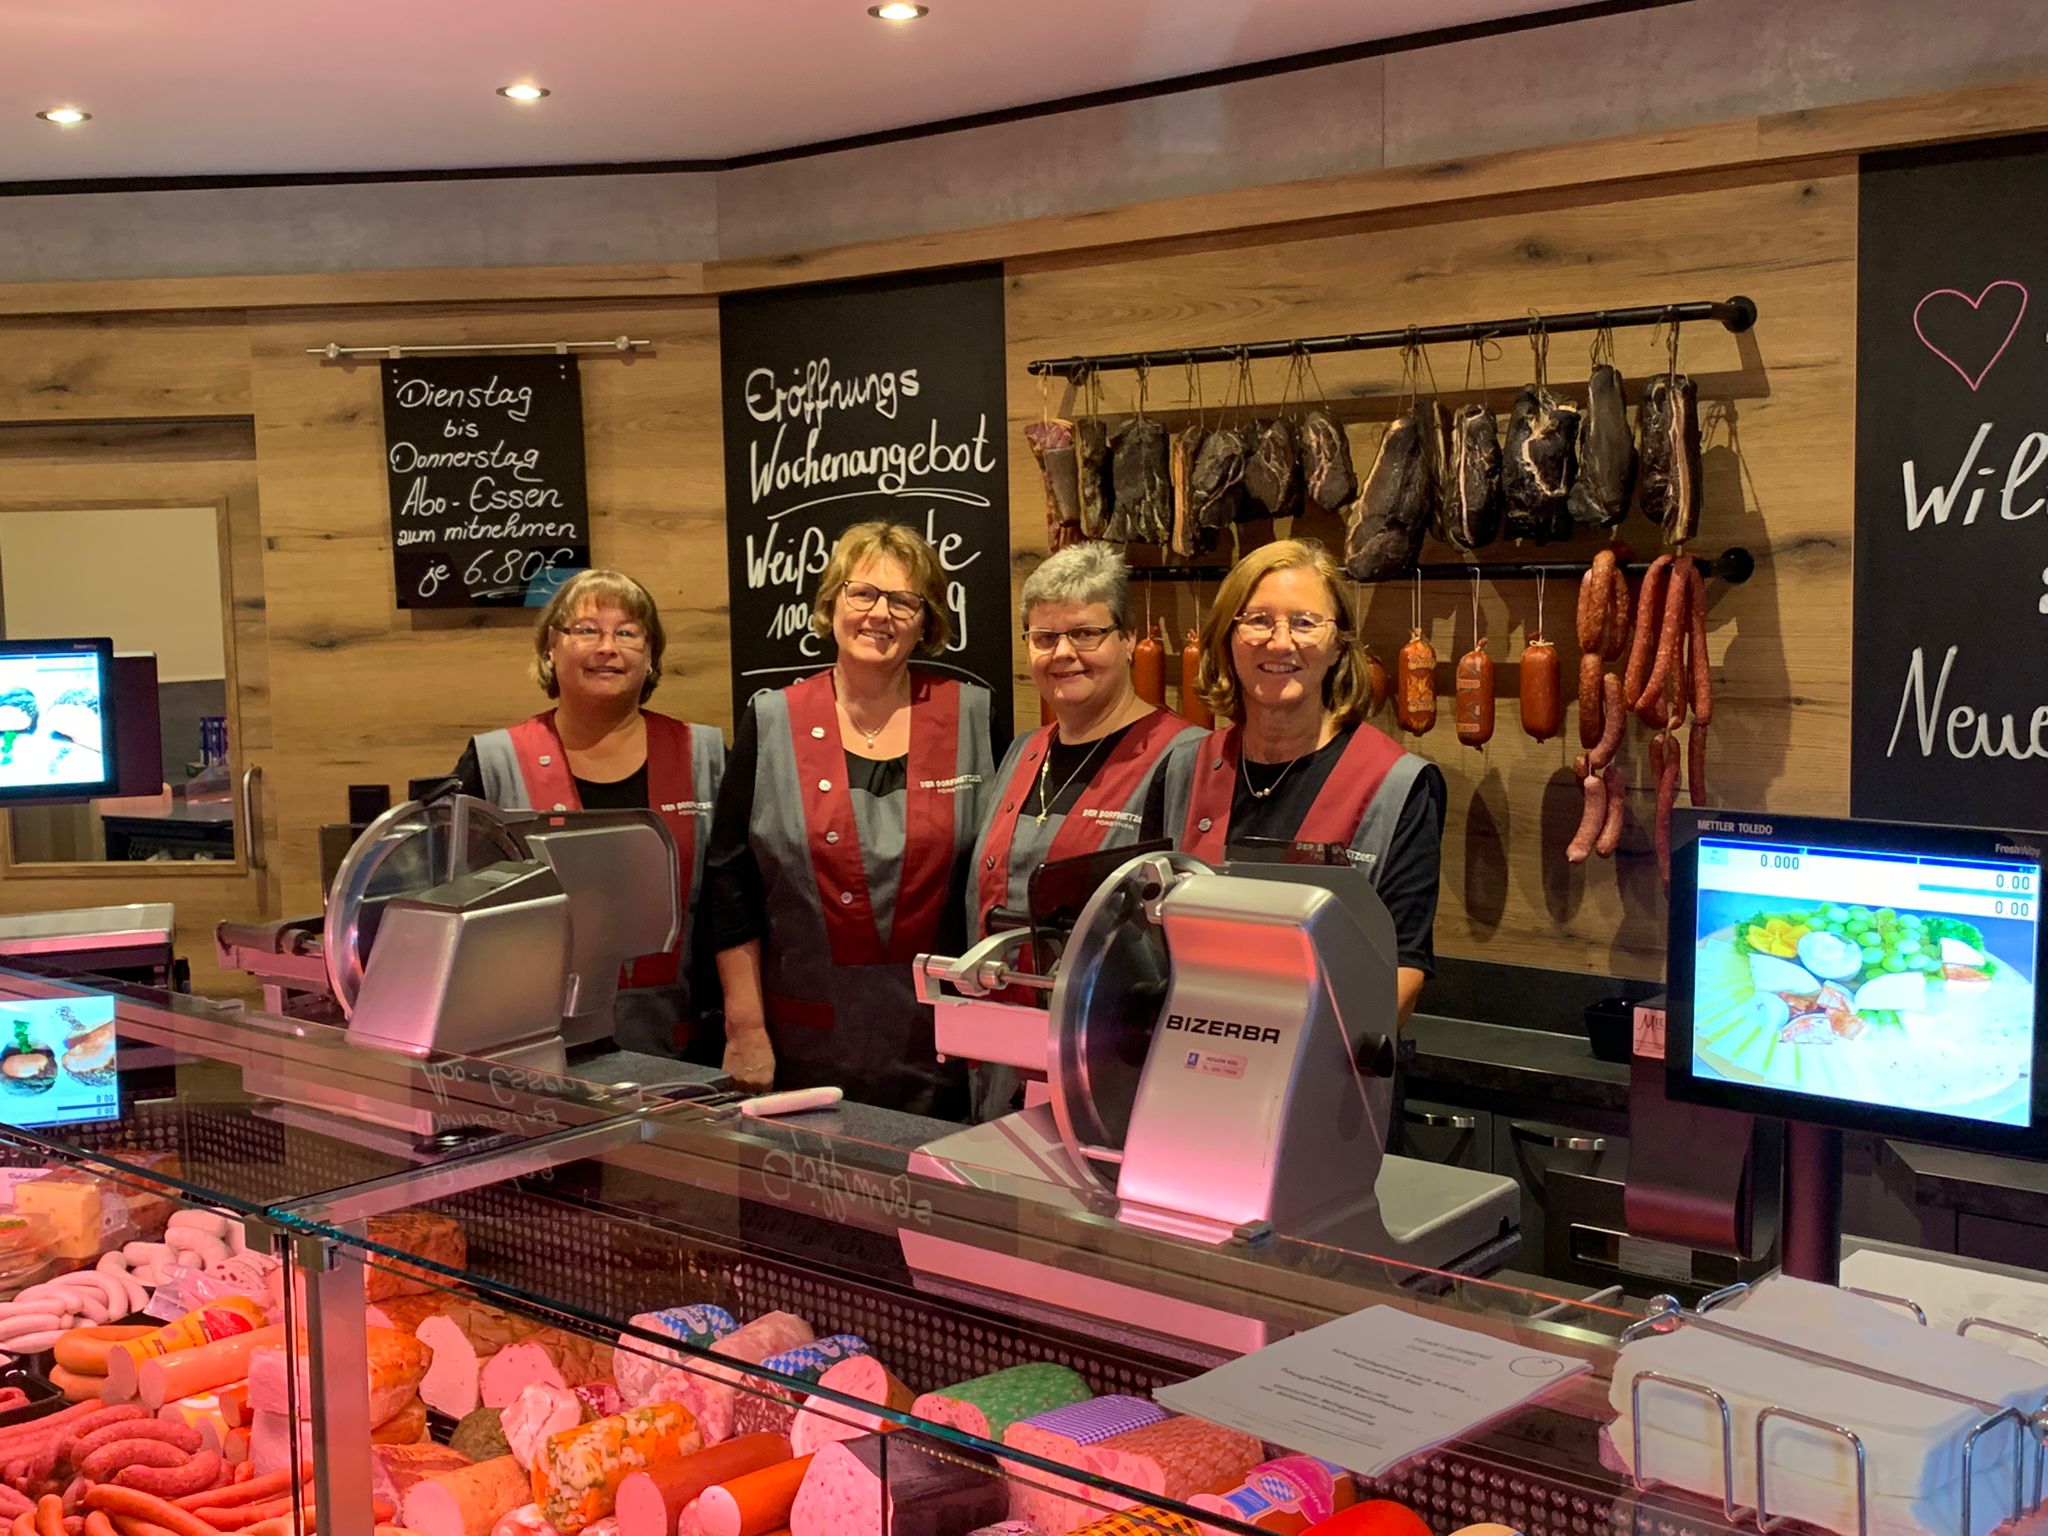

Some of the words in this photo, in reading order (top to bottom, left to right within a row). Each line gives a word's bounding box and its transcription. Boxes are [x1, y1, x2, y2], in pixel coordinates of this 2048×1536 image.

[396, 375, 533, 423] Dienstag
[745, 357, 920, 430] Eröffnungs
[443, 418, 479, 438] bis
[389, 439, 544, 483] Donnerstag
[749, 412, 996, 504] Wochenangebot
[1902, 422, 2048, 531] Wil
[397, 527, 436, 547] zum
[443, 512, 577, 543] mitnehmen
[417, 560, 450, 598] je
[1697, 819, 1735, 833] METTLER
[1738, 822, 1773, 836] TOLEDO
[1760, 854, 1800, 870] 0.000
[1996, 873, 2031, 891] 0.00
[1995, 900, 2030, 918] 0.00
[1166, 1014, 1281, 1045] BIZERBA
